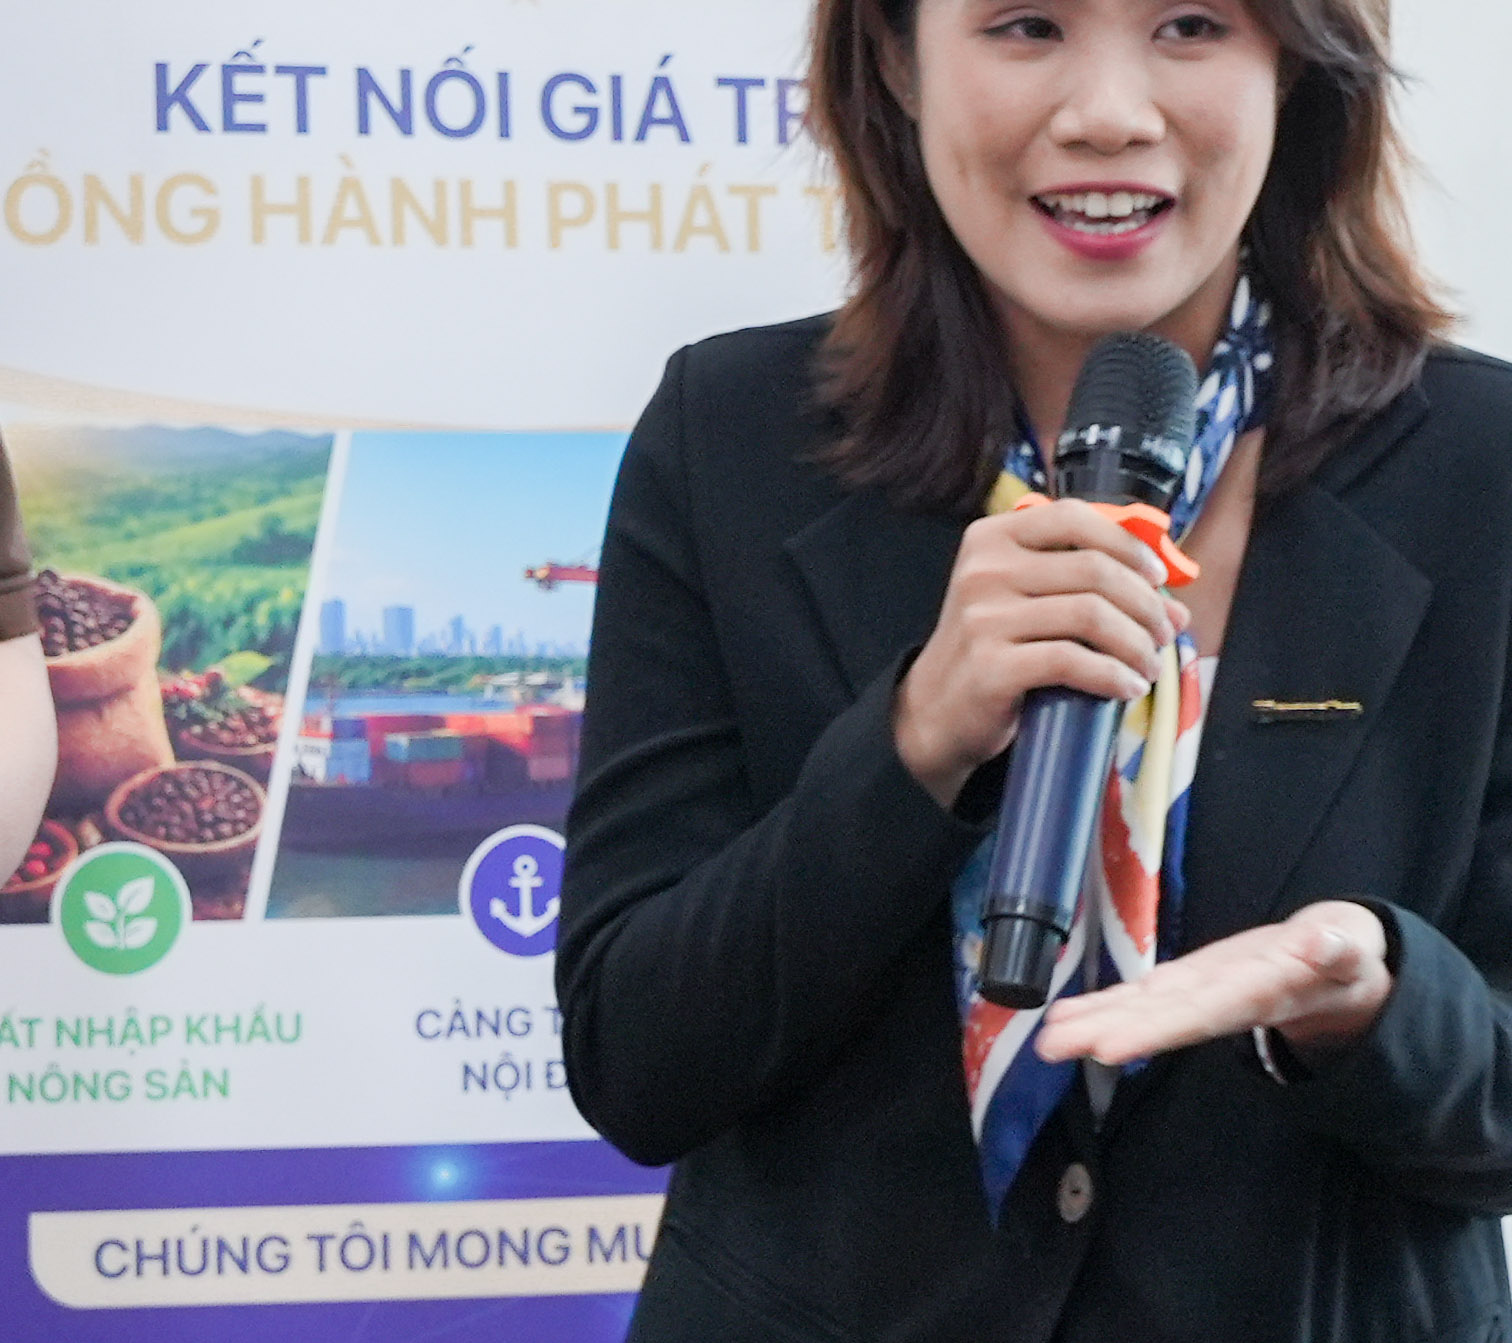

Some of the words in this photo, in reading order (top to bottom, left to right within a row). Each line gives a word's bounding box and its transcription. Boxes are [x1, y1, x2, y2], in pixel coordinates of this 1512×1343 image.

[155, 40, 327, 136] KẾT
[356, 47, 510, 139] NỐI
[540, 57, 690, 144] GIÁ
[715, 76, 810, 147] TR
[249, 154, 520, 250] HÀNH
[546, 162, 777, 254] PHÁT
[54, 1006, 172, 1056] NHẬP
[186, 1001, 304, 1046] KHẨU
[415, 997, 532, 1041] CẢNG
[8, 1064, 131, 1105] NÔNG
[150, 1058, 231, 1101] SẢN
[462, 1051, 531, 1101] NỘI
[93, 1225, 291, 1281] CHÚNG
[305, 1221, 390, 1274] TÔI
[407, 1227, 571, 1274] MONG
